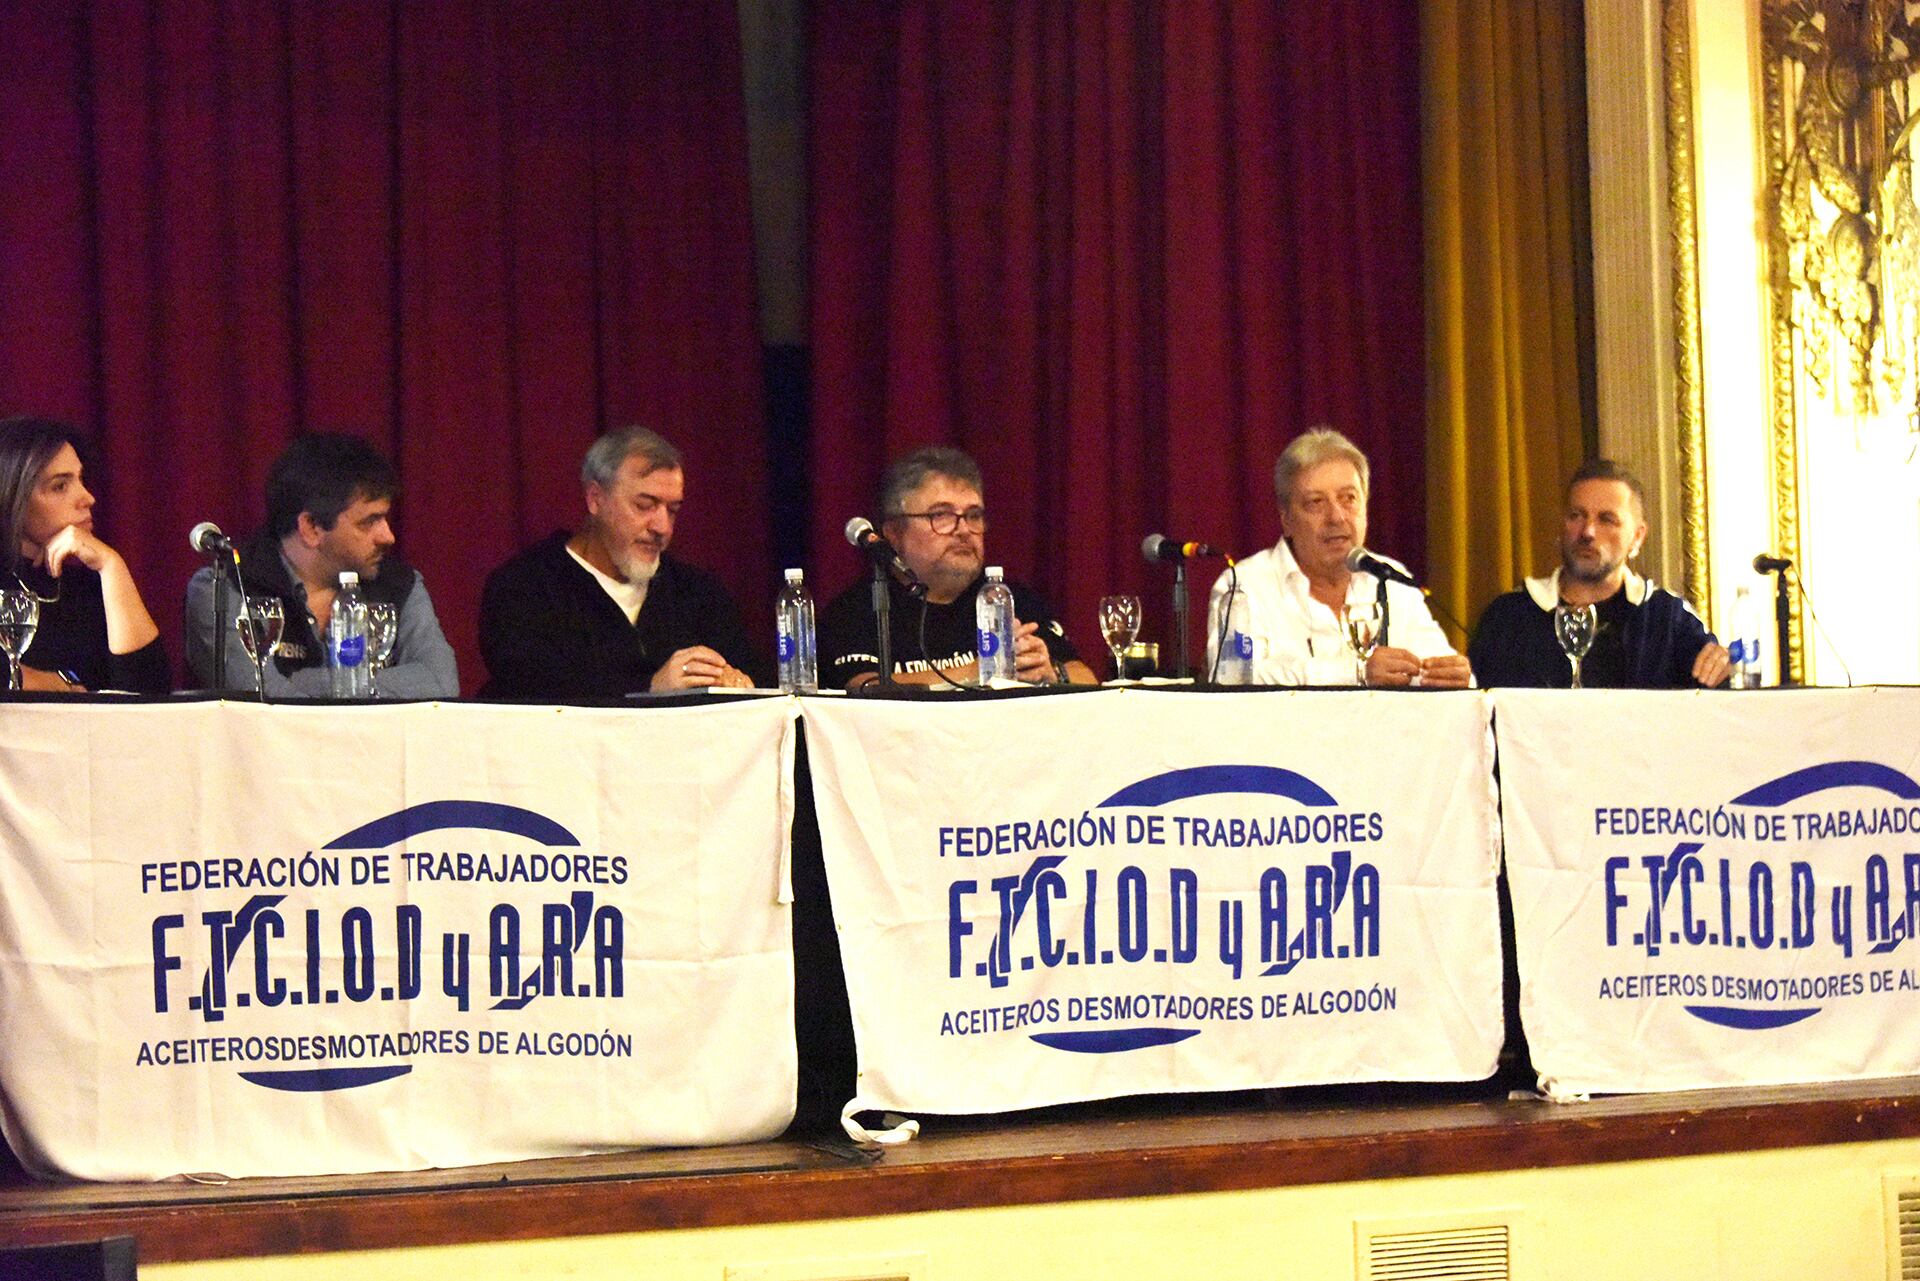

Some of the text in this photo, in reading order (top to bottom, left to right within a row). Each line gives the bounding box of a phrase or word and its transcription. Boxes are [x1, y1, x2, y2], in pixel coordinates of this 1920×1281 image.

[940, 811, 1383, 857] FEDERACIÓN DE TRABAJADORES
[1596, 805, 1746, 840] FEDERACIÓN
[1755, 815, 1787, 841] DE
[142, 852, 628, 893] FEDERACIÓN DE TRABAJADORES
[1220, 900, 1242, 980] y
[1831, 885, 1852, 958] y
[443, 932, 470, 1011] y
[1599, 969, 1920, 1002] ACEITEROS DESMOTADORES DE AL
[940, 984, 1396, 1036] ACEITEROS DESMOTADORES DE ALGODÓN
[479, 1030, 509, 1055] DE
[516, 1028, 632, 1057] ALGODÓN
